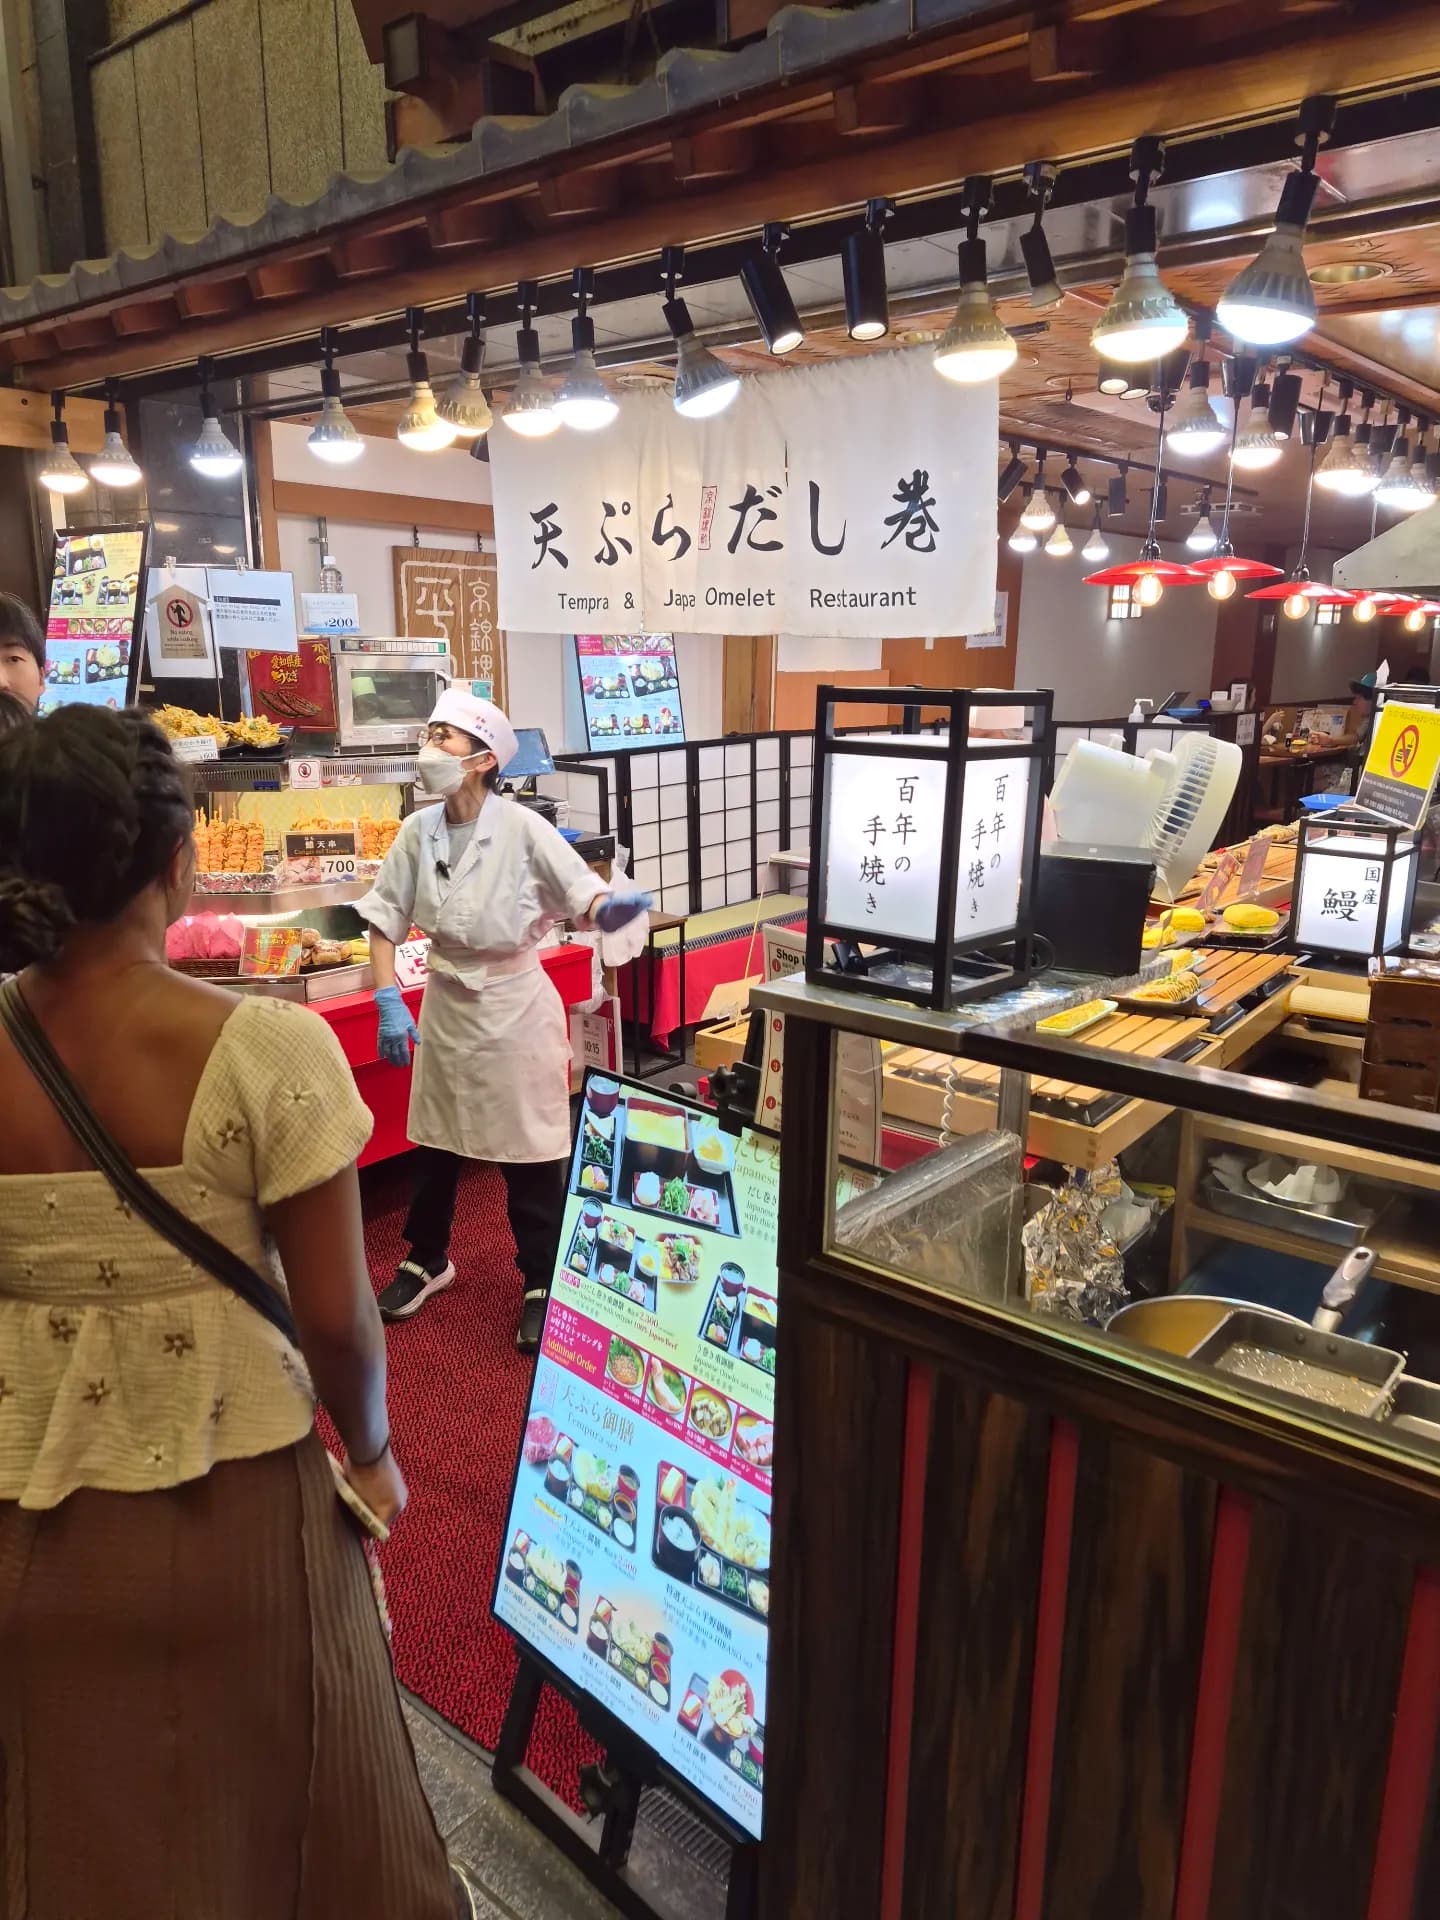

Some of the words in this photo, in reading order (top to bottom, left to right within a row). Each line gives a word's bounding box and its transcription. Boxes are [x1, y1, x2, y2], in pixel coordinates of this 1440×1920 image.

[558, 592, 609, 613] Tempra
[624, 592, 635, 609] &
[705, 586, 776, 607] Omelet
[810, 585, 918, 608] Restaurant
[271, 655, 304, 668] 愛知県産
[892, 775, 920, 873] 百年の
[990, 773, 1010, 870] 百年の
[859, 815, 887, 914] 手焼き
[967, 817, 987, 919] 手焼き
[1320, 887, 1359, 922] 鰻
[1361, 866, 1381, 906] 国産
[776, 948, 800, 966] Shop
[576, 1353, 597, 1375] Order
